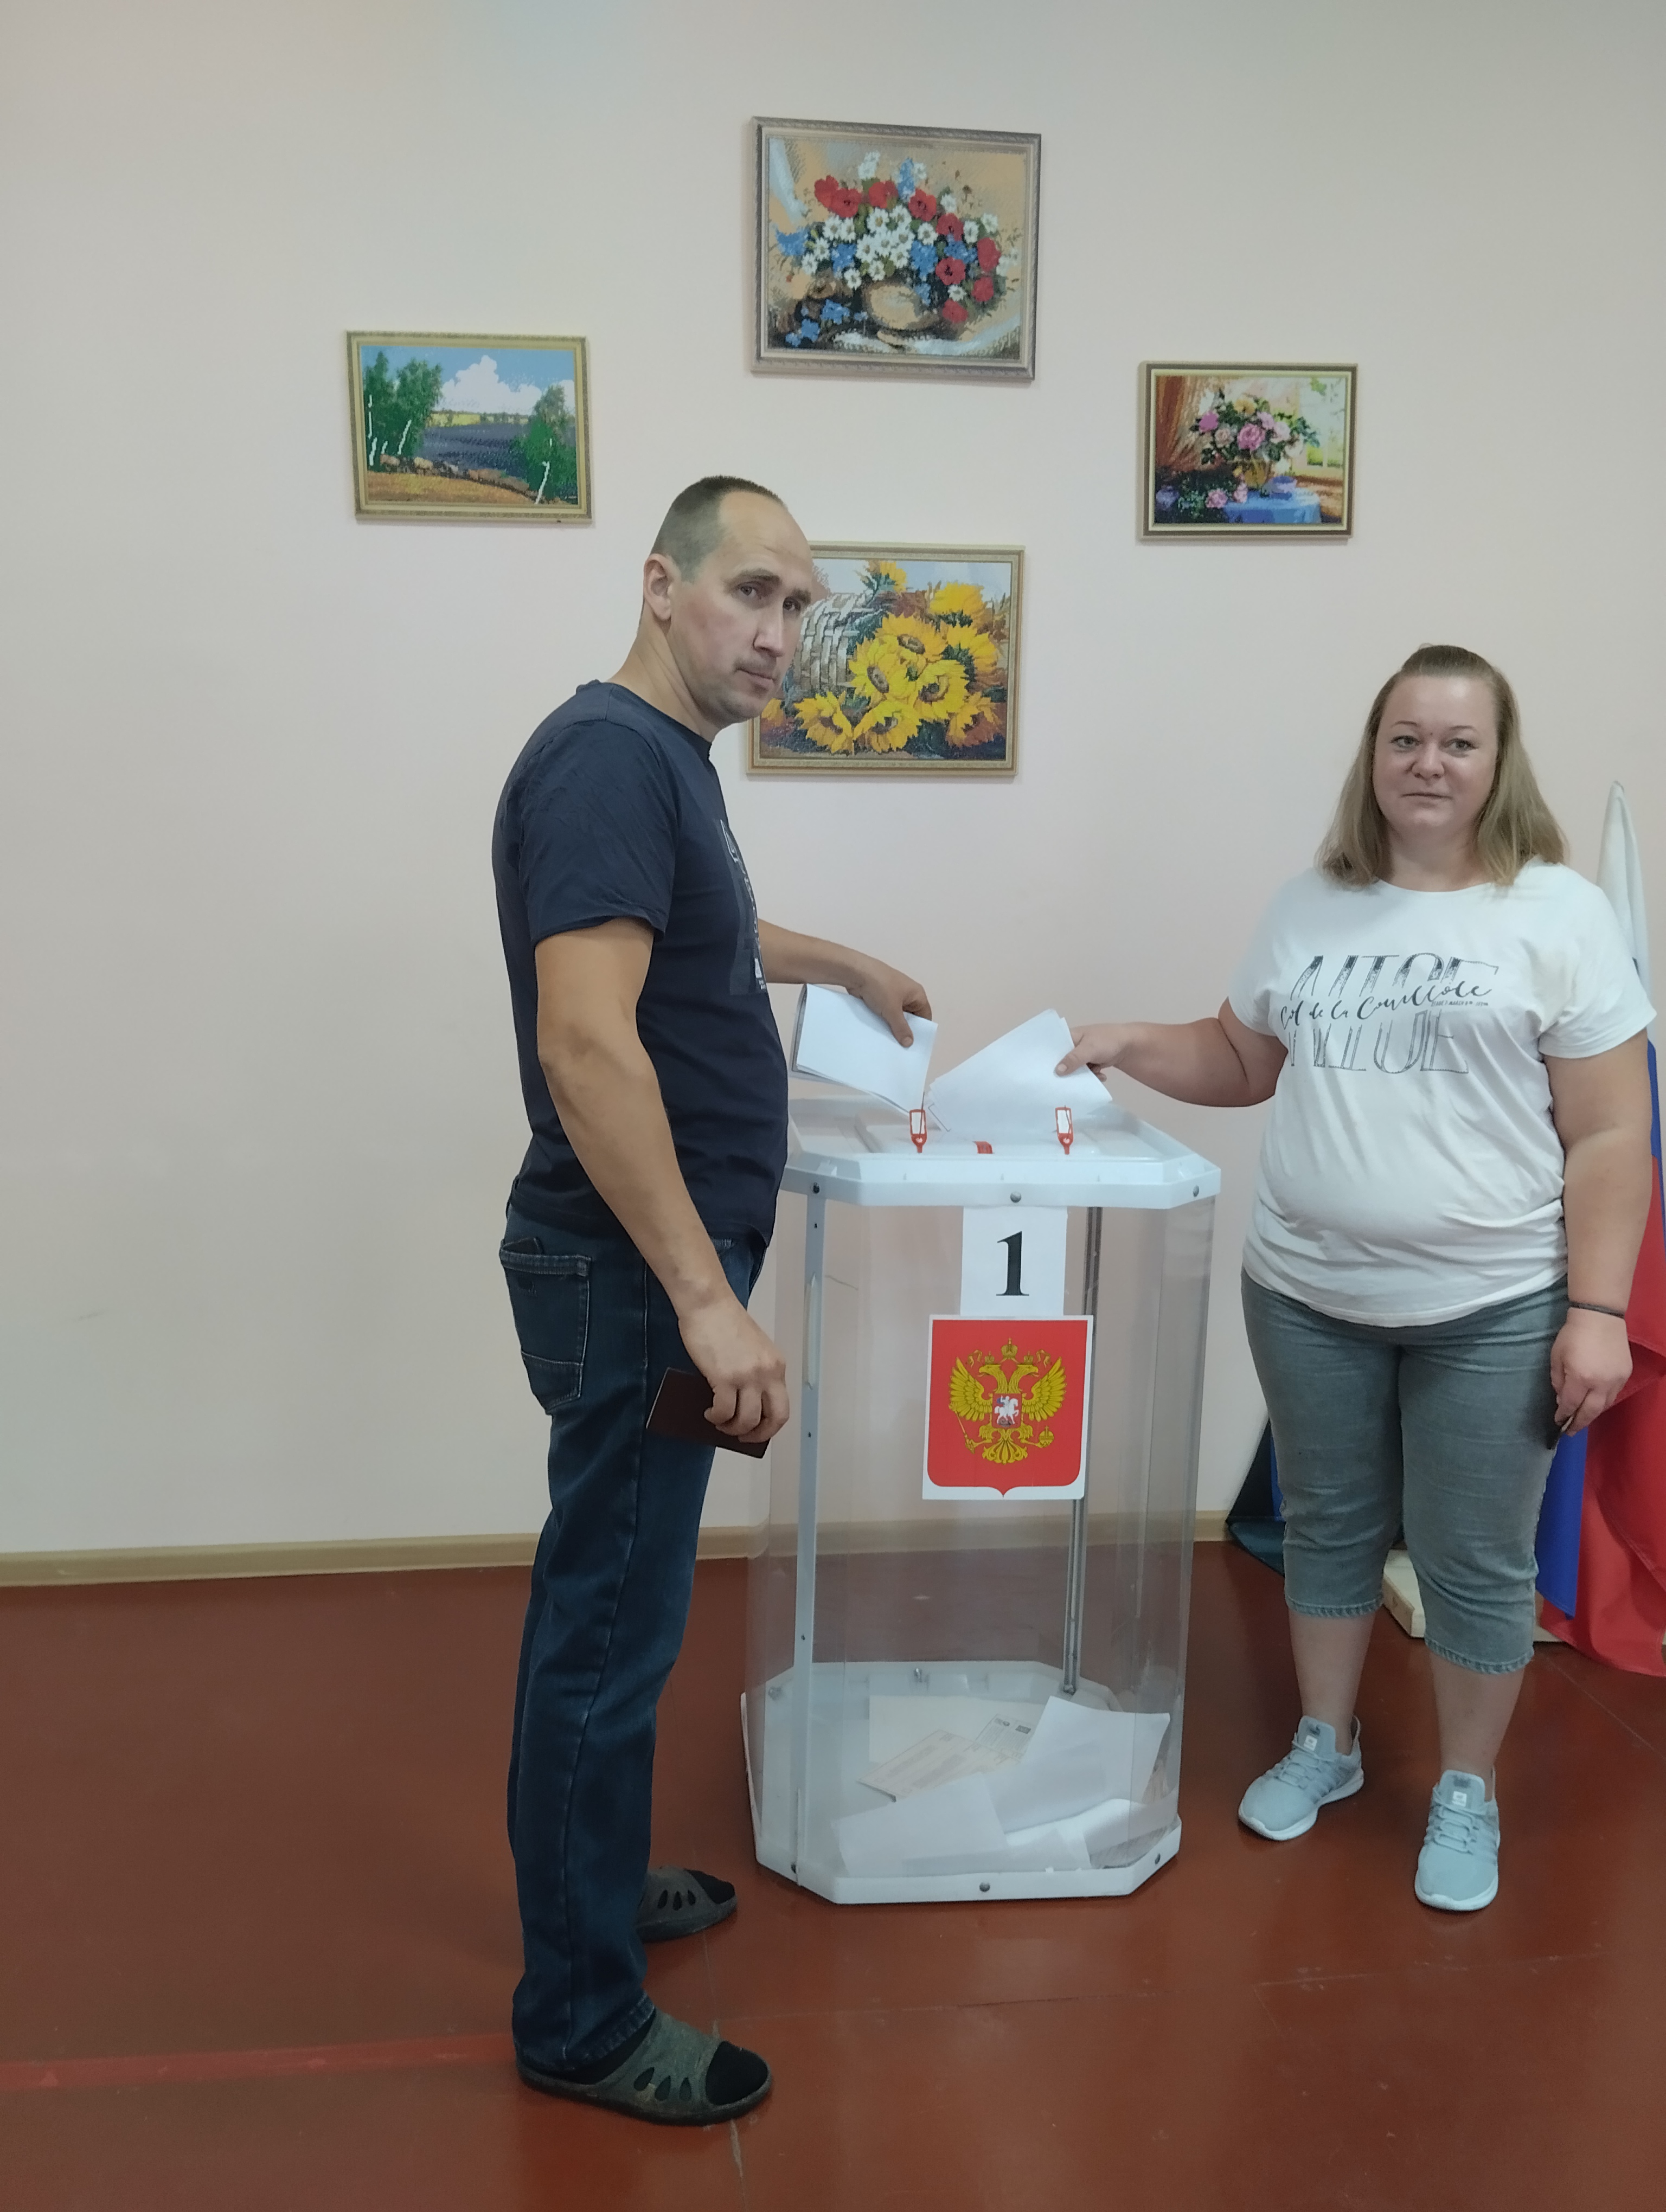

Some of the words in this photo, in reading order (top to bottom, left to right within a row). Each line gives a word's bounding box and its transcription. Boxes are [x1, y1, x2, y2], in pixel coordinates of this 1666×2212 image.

[1309, 1002, 1324, 1019] de
[1331, 1000, 1349, 1020] la
[996, 1231, 1030, 1296] 1
